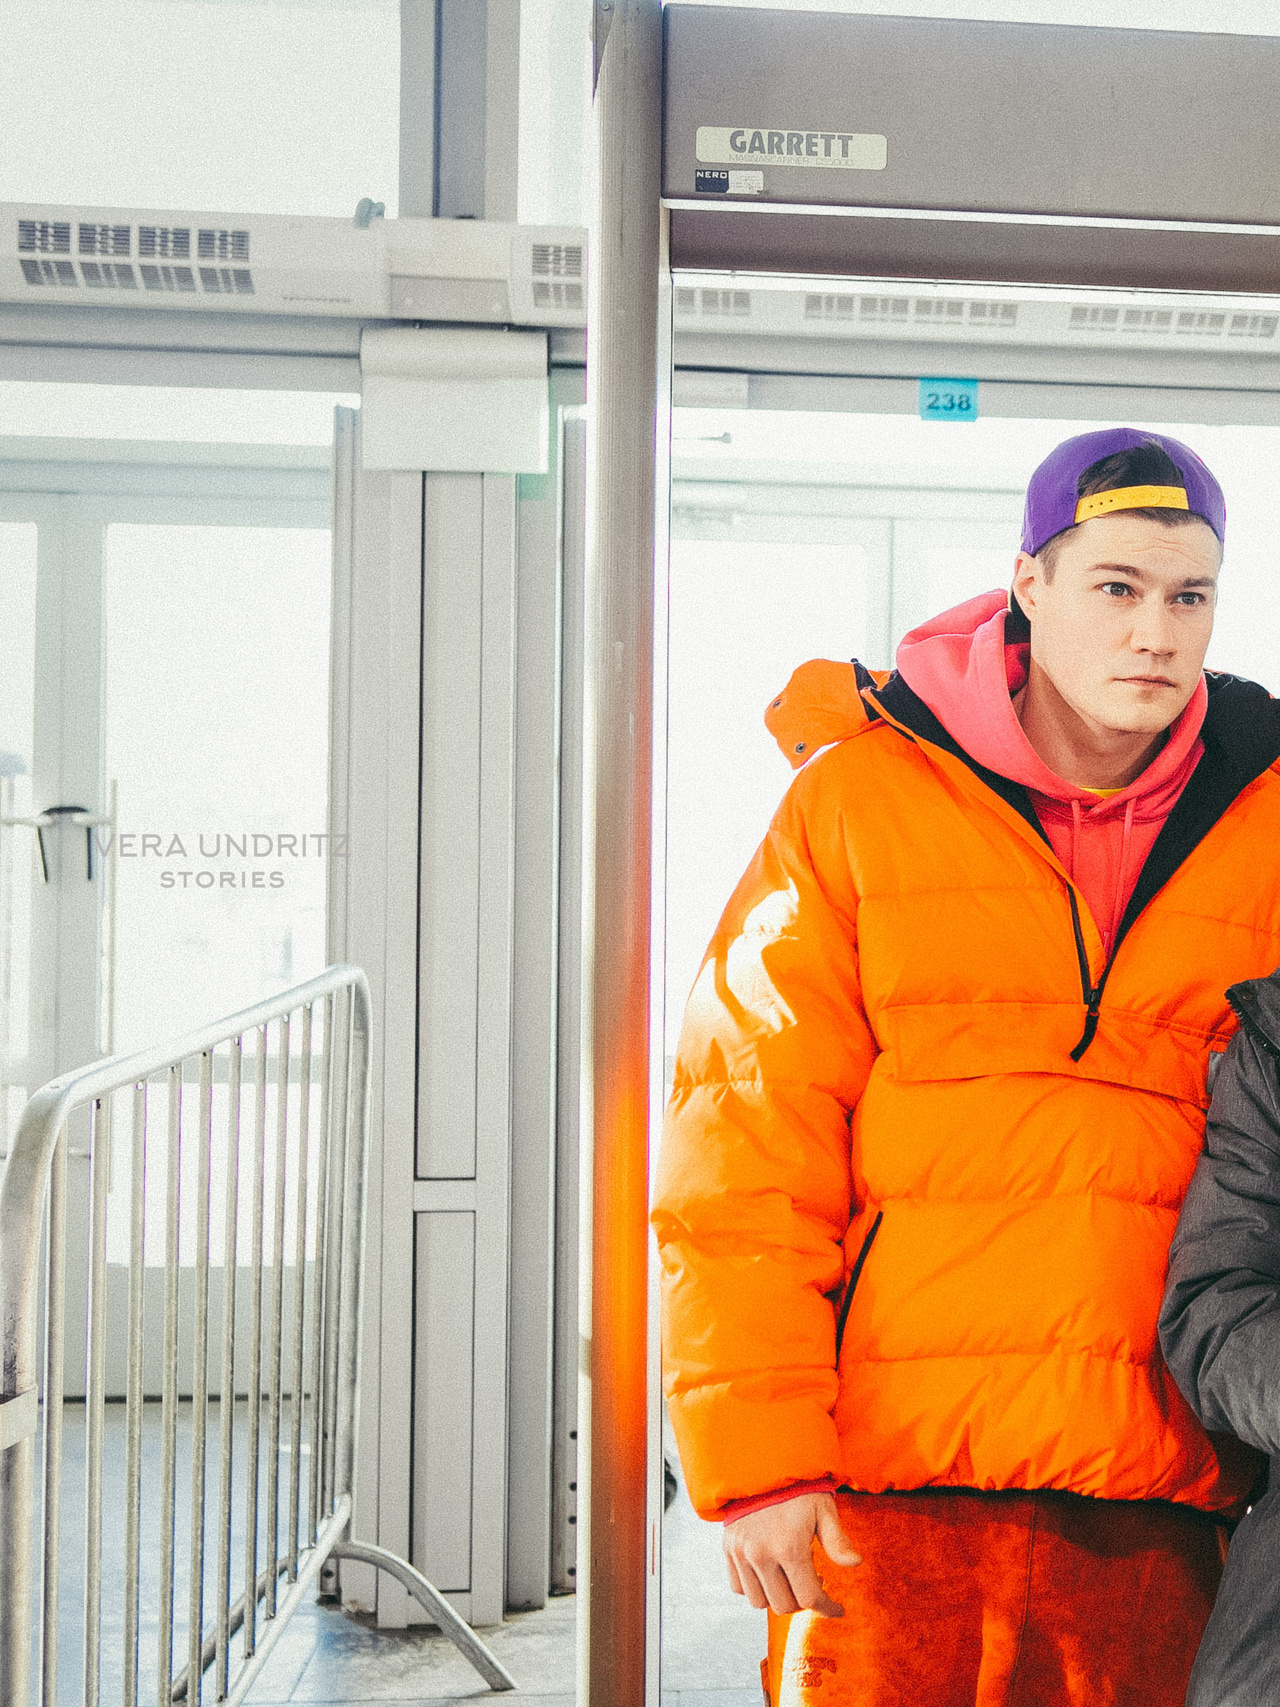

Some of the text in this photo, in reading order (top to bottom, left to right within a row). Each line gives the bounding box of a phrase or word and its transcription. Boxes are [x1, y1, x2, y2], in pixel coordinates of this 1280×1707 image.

[729, 130, 854, 158] GARRETT
[696, 171, 728, 179] NERO
[926, 393, 972, 411] 238
